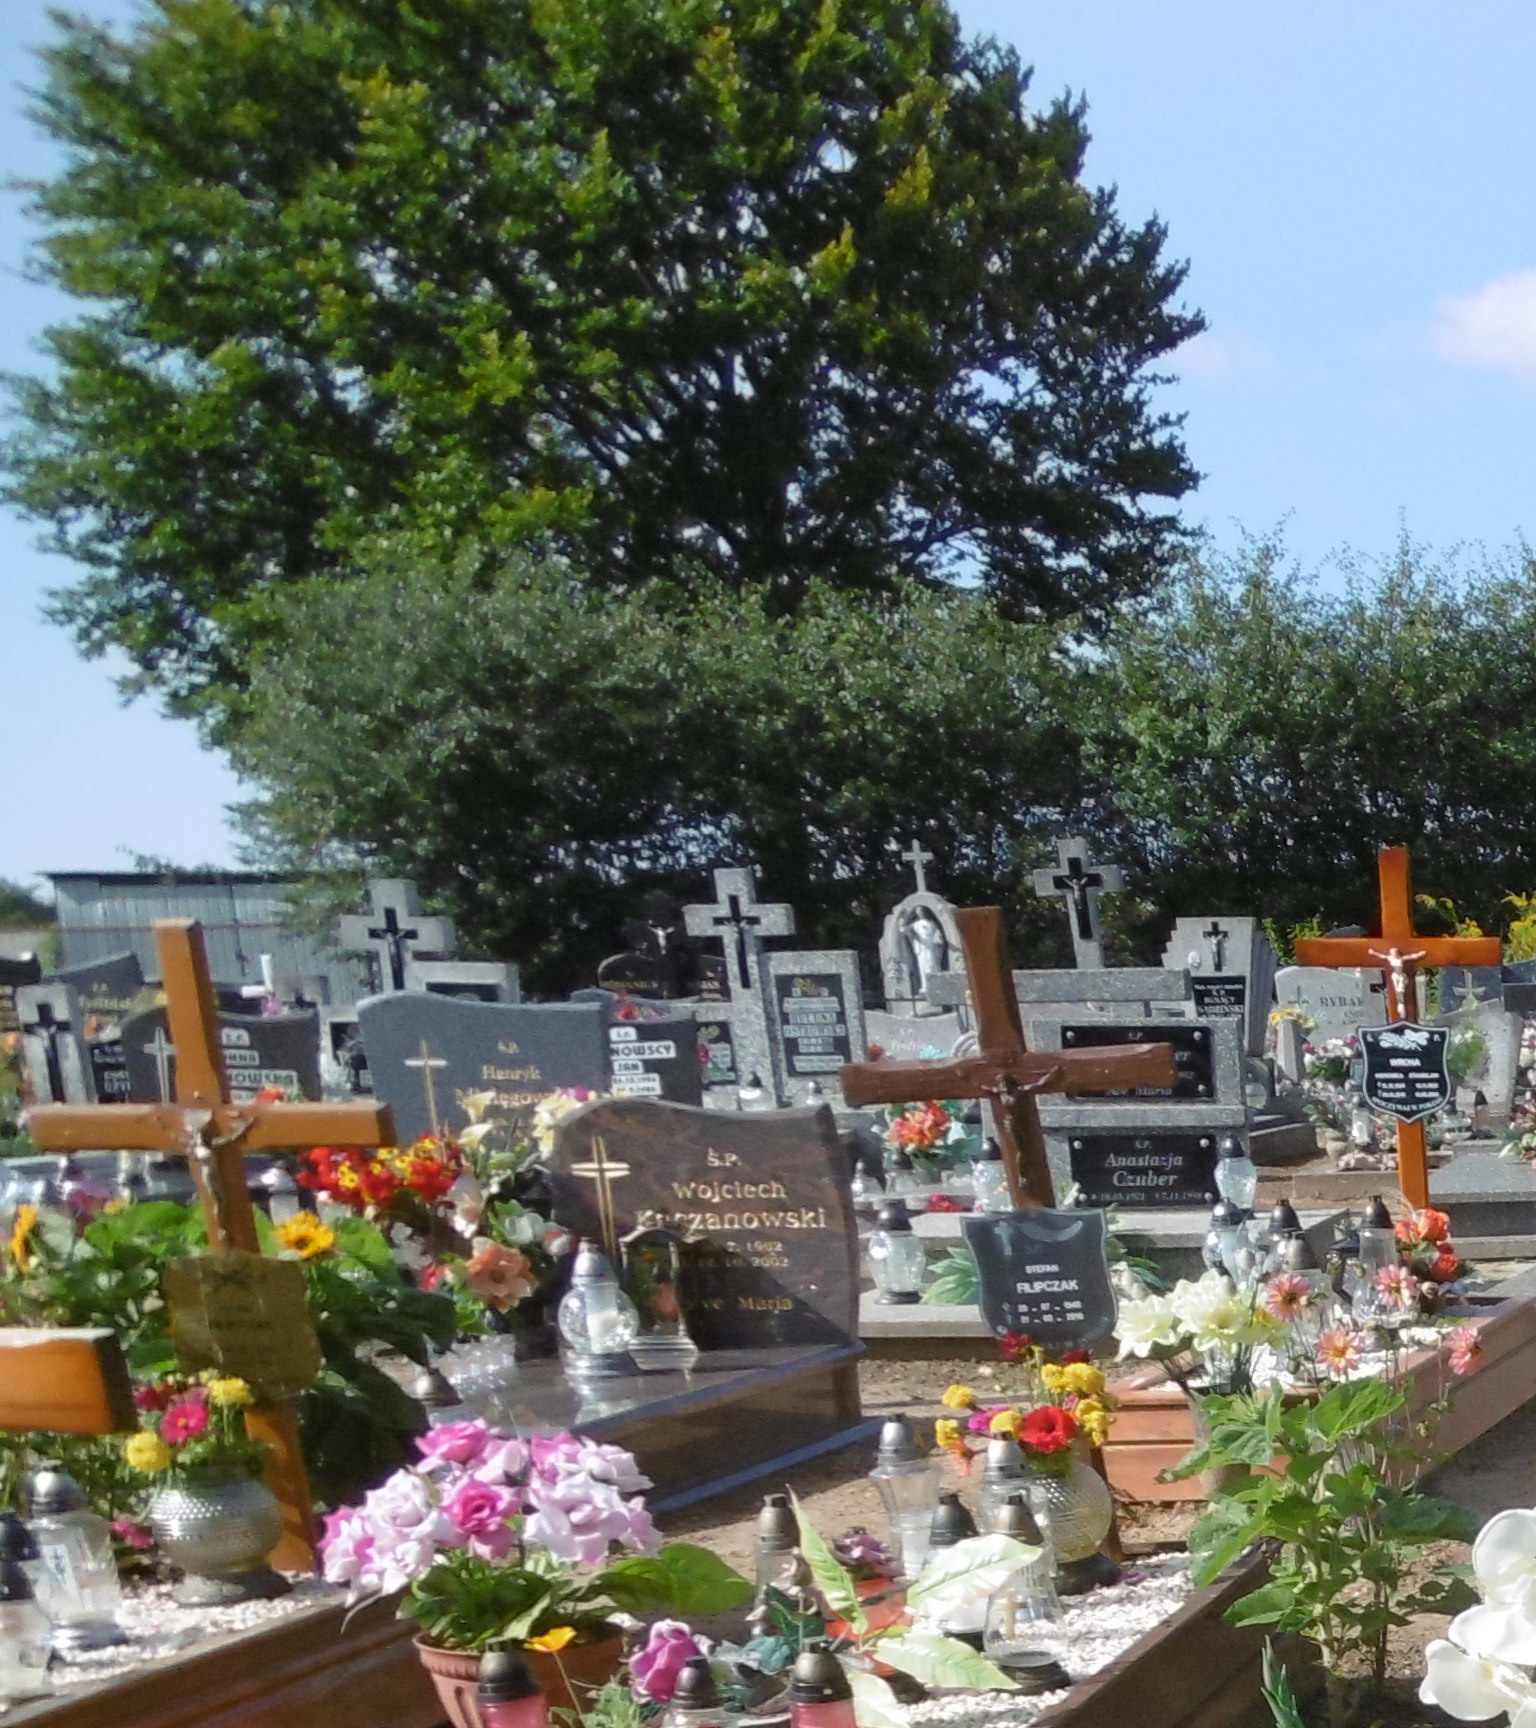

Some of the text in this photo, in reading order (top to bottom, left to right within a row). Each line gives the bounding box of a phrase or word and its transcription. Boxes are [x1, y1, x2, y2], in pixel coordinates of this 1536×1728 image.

[1105, 1152, 1184, 1172] Anastazja
[1112, 1170, 1179, 1188] Czuber
[671, 1180, 788, 1203] Wojciech
[1016, 1279, 1080, 1294] FILIPCZAK
